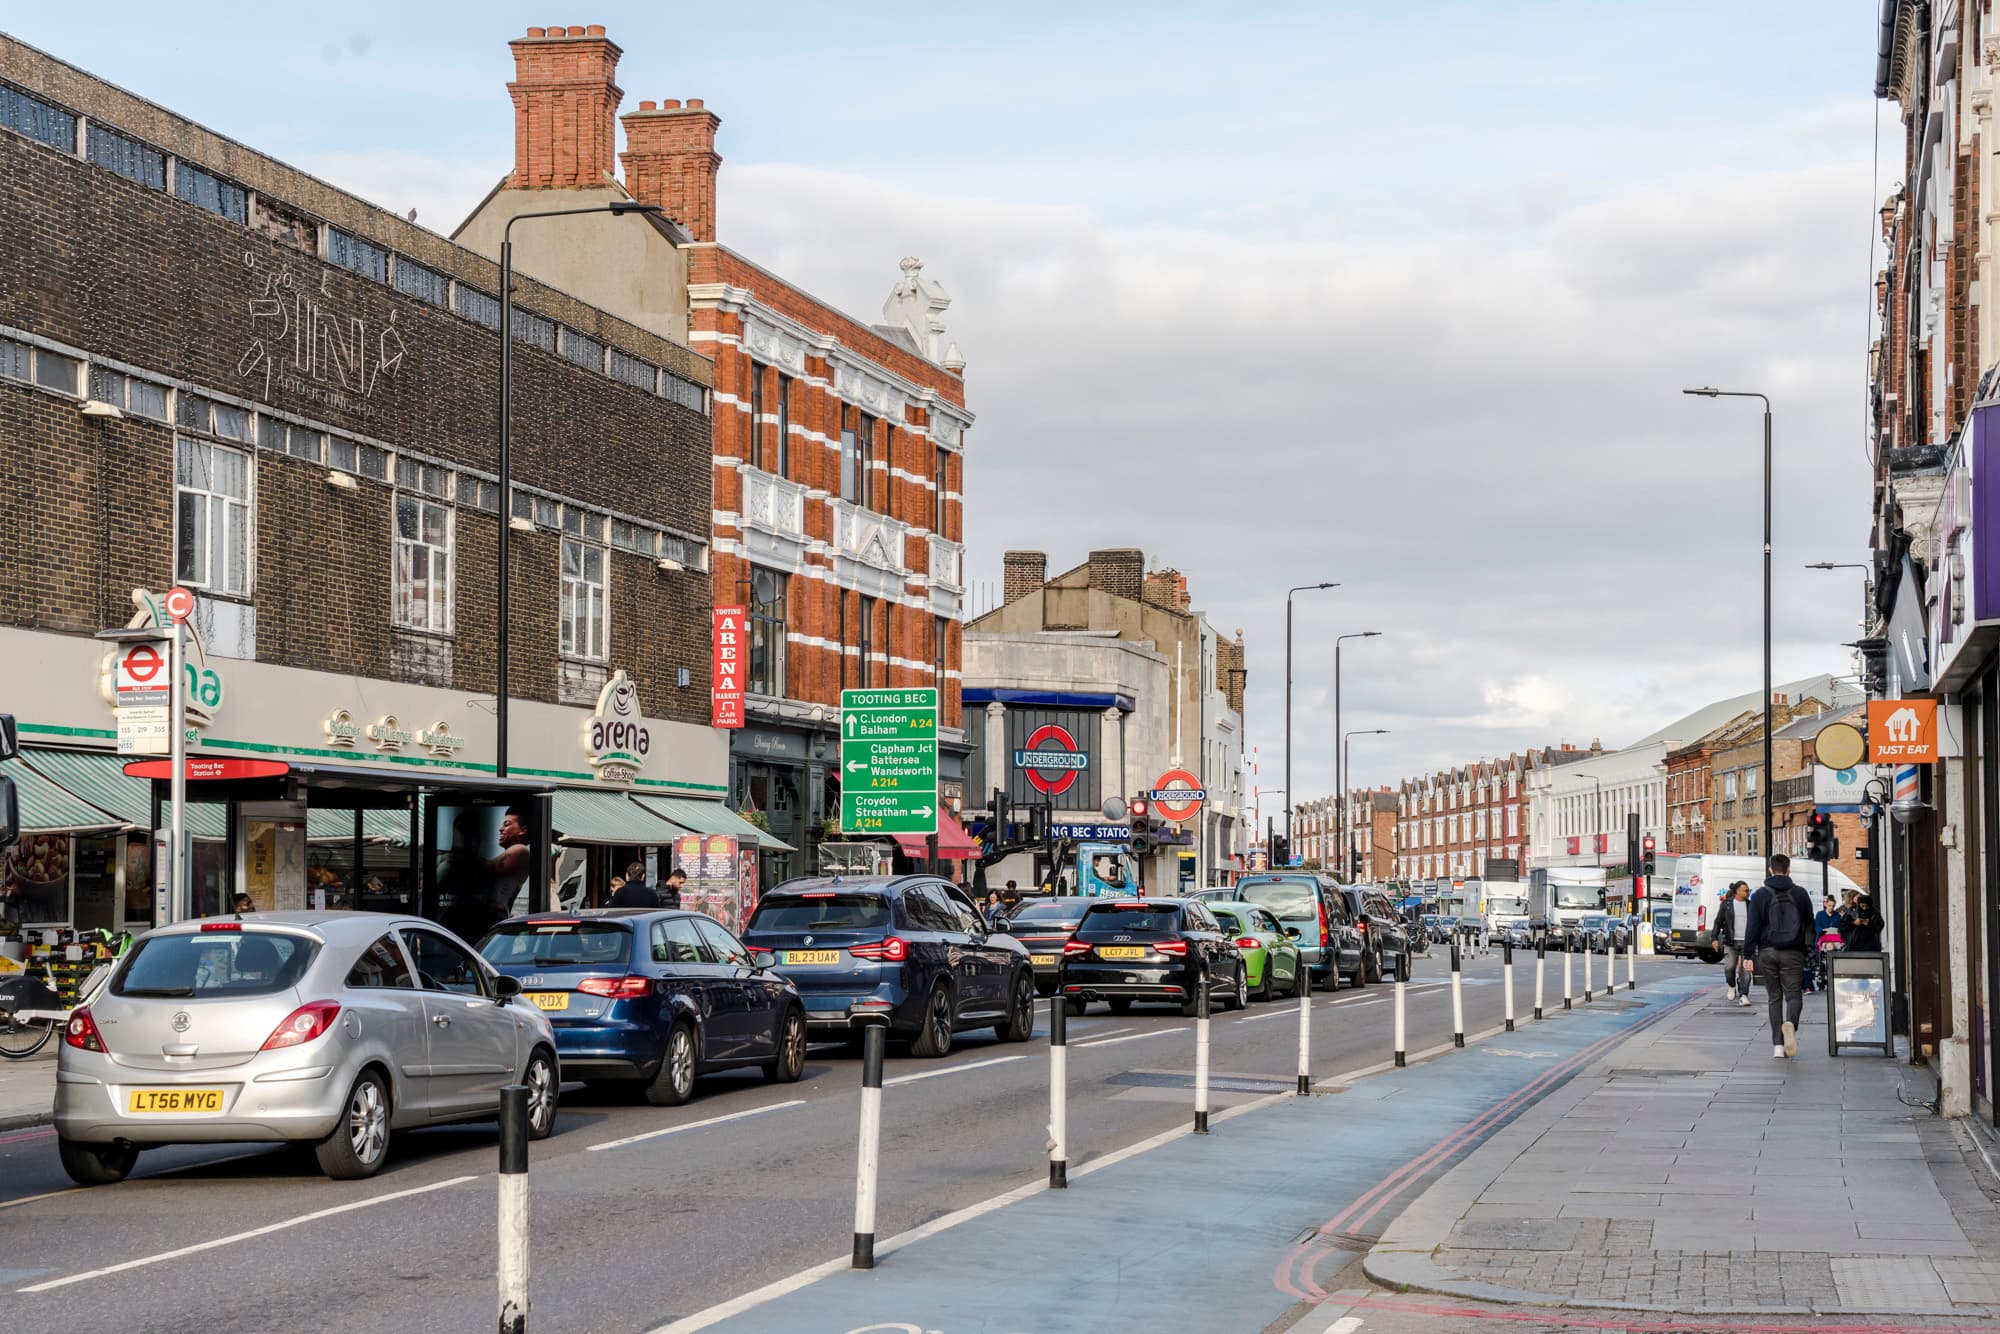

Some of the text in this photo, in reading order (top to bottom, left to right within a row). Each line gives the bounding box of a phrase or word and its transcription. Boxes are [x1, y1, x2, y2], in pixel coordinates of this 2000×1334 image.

[168, 593, 186, 615] C
[719, 617, 736, 690] ARENA
[851, 693, 927, 704] TOOTING BEC
[860, 713, 907, 724] C.London
[909, 718, 933, 728] A 24
[330, 719, 361, 737] Butcher
[860, 725, 898, 735] Balham
[593, 721, 650, 755] arena
[870, 743, 933, 755] Clapham Jct
[1877, 744, 1930, 756] JUST EAT
[871, 755, 920, 765] Battersea
[1015, 751, 1087, 769] UNDERGROUND
[190, 762, 225, 771] Tooting Bec
[870, 766, 933, 776] Wandsworth
[193, 769, 214, 777] Station
[871, 778, 898, 787] A 214
[1150, 790, 1205, 800] UNDERGROUND
[855, 796, 898, 807] Croydon
[855, 807, 908, 817] Streatham
[855, 818, 882, 827] A 214
[1072, 826, 1091, 838] BEC
[1096, 826, 1130, 838] STATIO
[788, 953, 838, 963] BL23 UAK
[538, 995, 564, 1007] RDX
[136, 1092, 217, 1109] LT56 MYG
